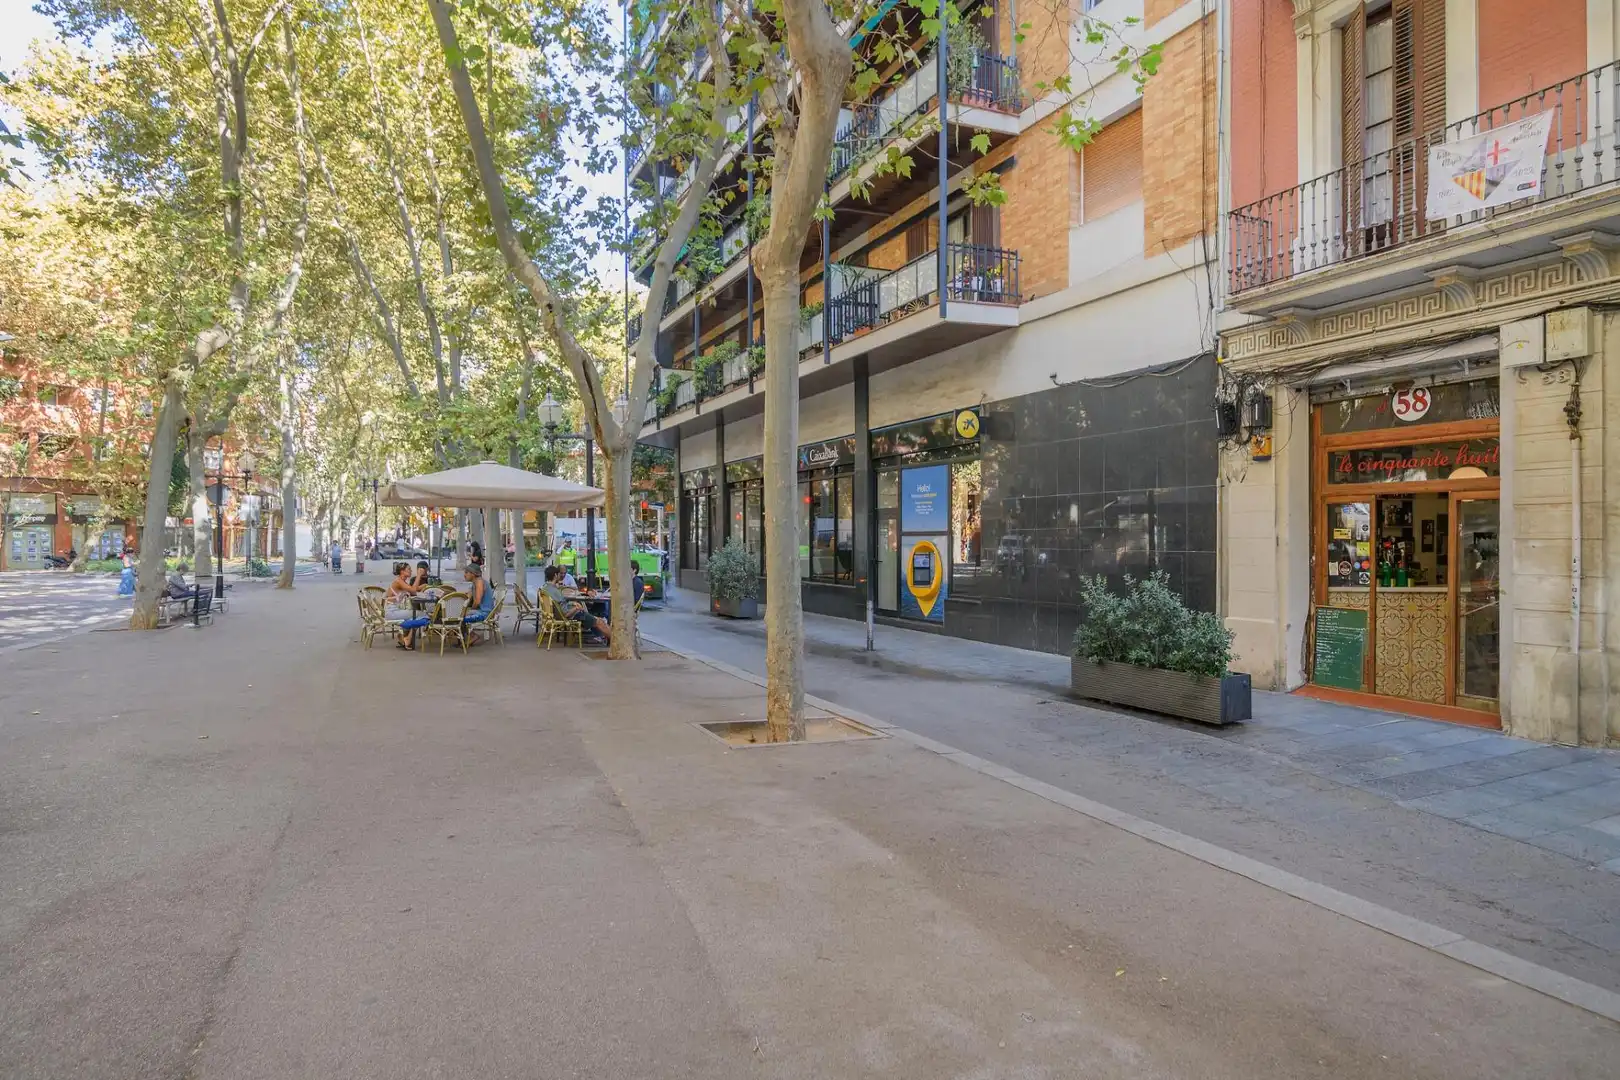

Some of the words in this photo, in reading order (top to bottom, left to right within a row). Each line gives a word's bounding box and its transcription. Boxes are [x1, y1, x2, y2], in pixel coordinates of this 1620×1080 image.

[1396, 388, 1428, 415] 58
[810, 444, 838, 462] CaixaBank
[1336, 455, 1353, 473] le
[1357, 449, 1449, 479] cinquante
[1455, 443, 1499, 465] huit
